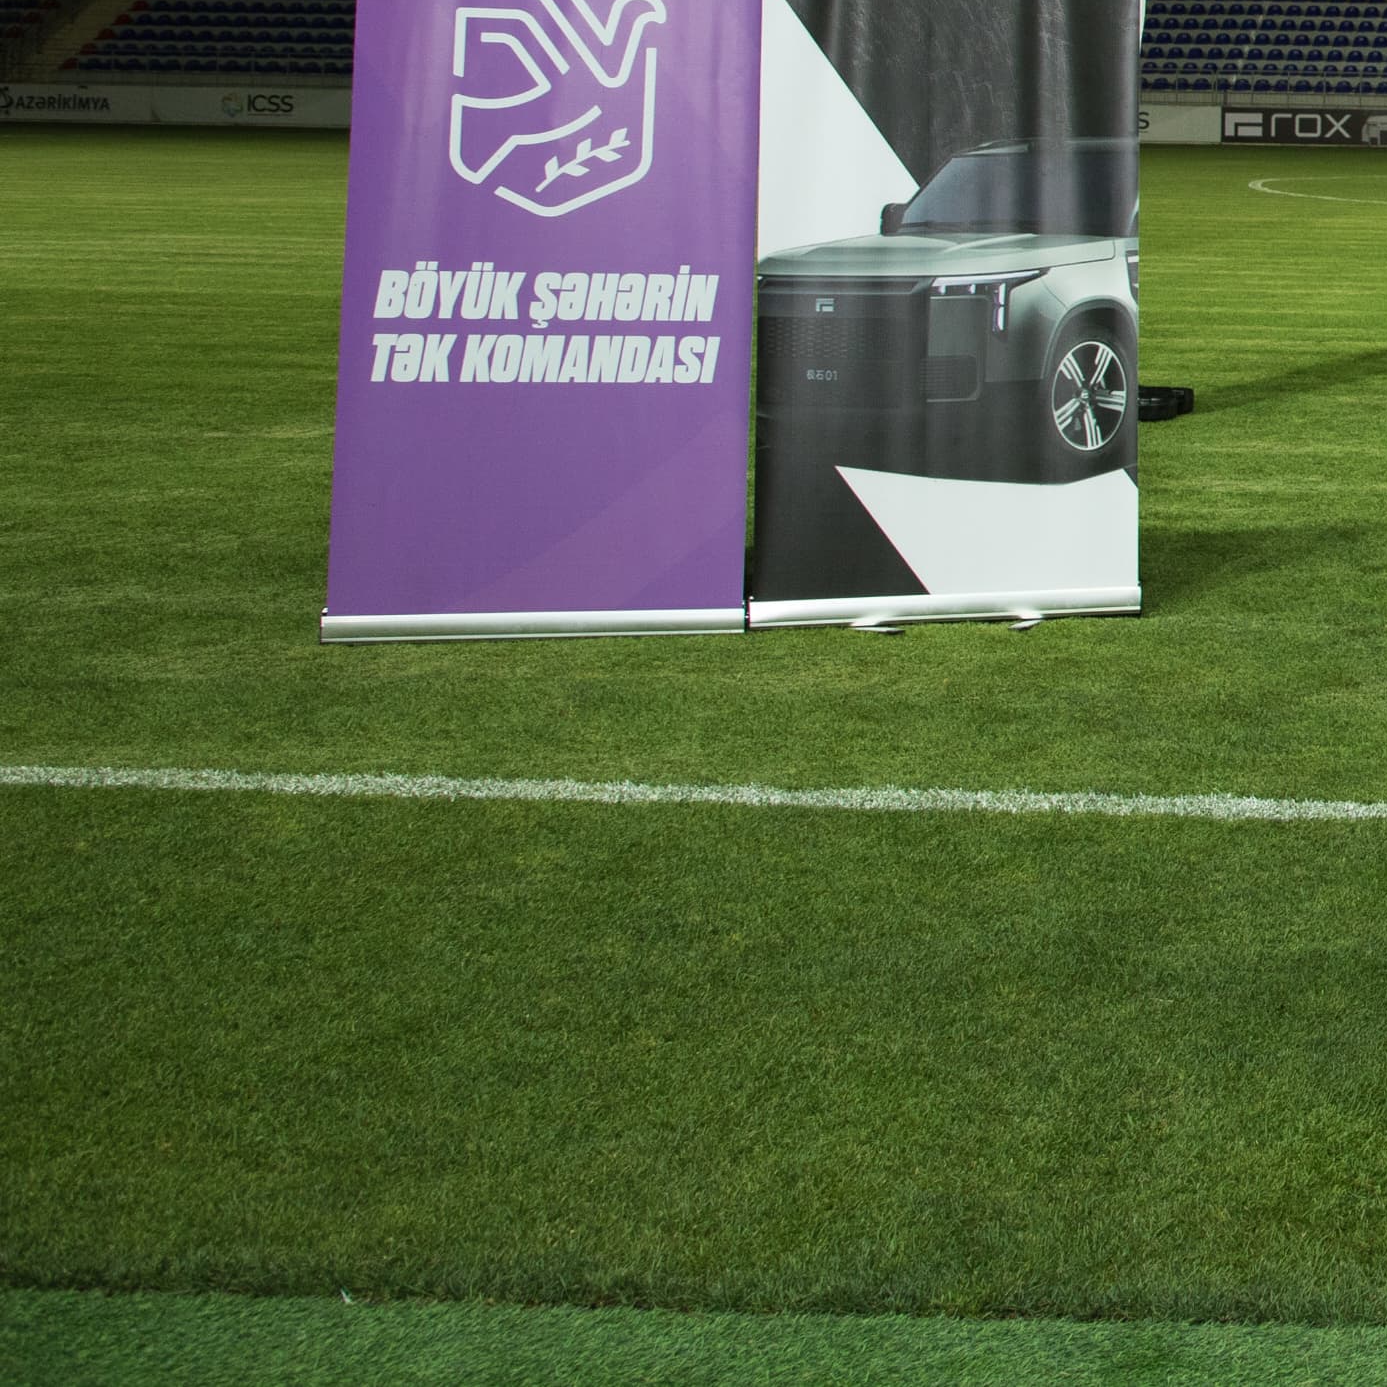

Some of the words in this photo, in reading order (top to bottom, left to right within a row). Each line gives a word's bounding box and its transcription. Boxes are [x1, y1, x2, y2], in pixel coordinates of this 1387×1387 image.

[247, 94, 294, 113] ICSS
[373, 261, 527, 320] BÖYÜK
[370, 333, 458, 383] TƏK
[459, 334, 721, 384] KOMANDASI
